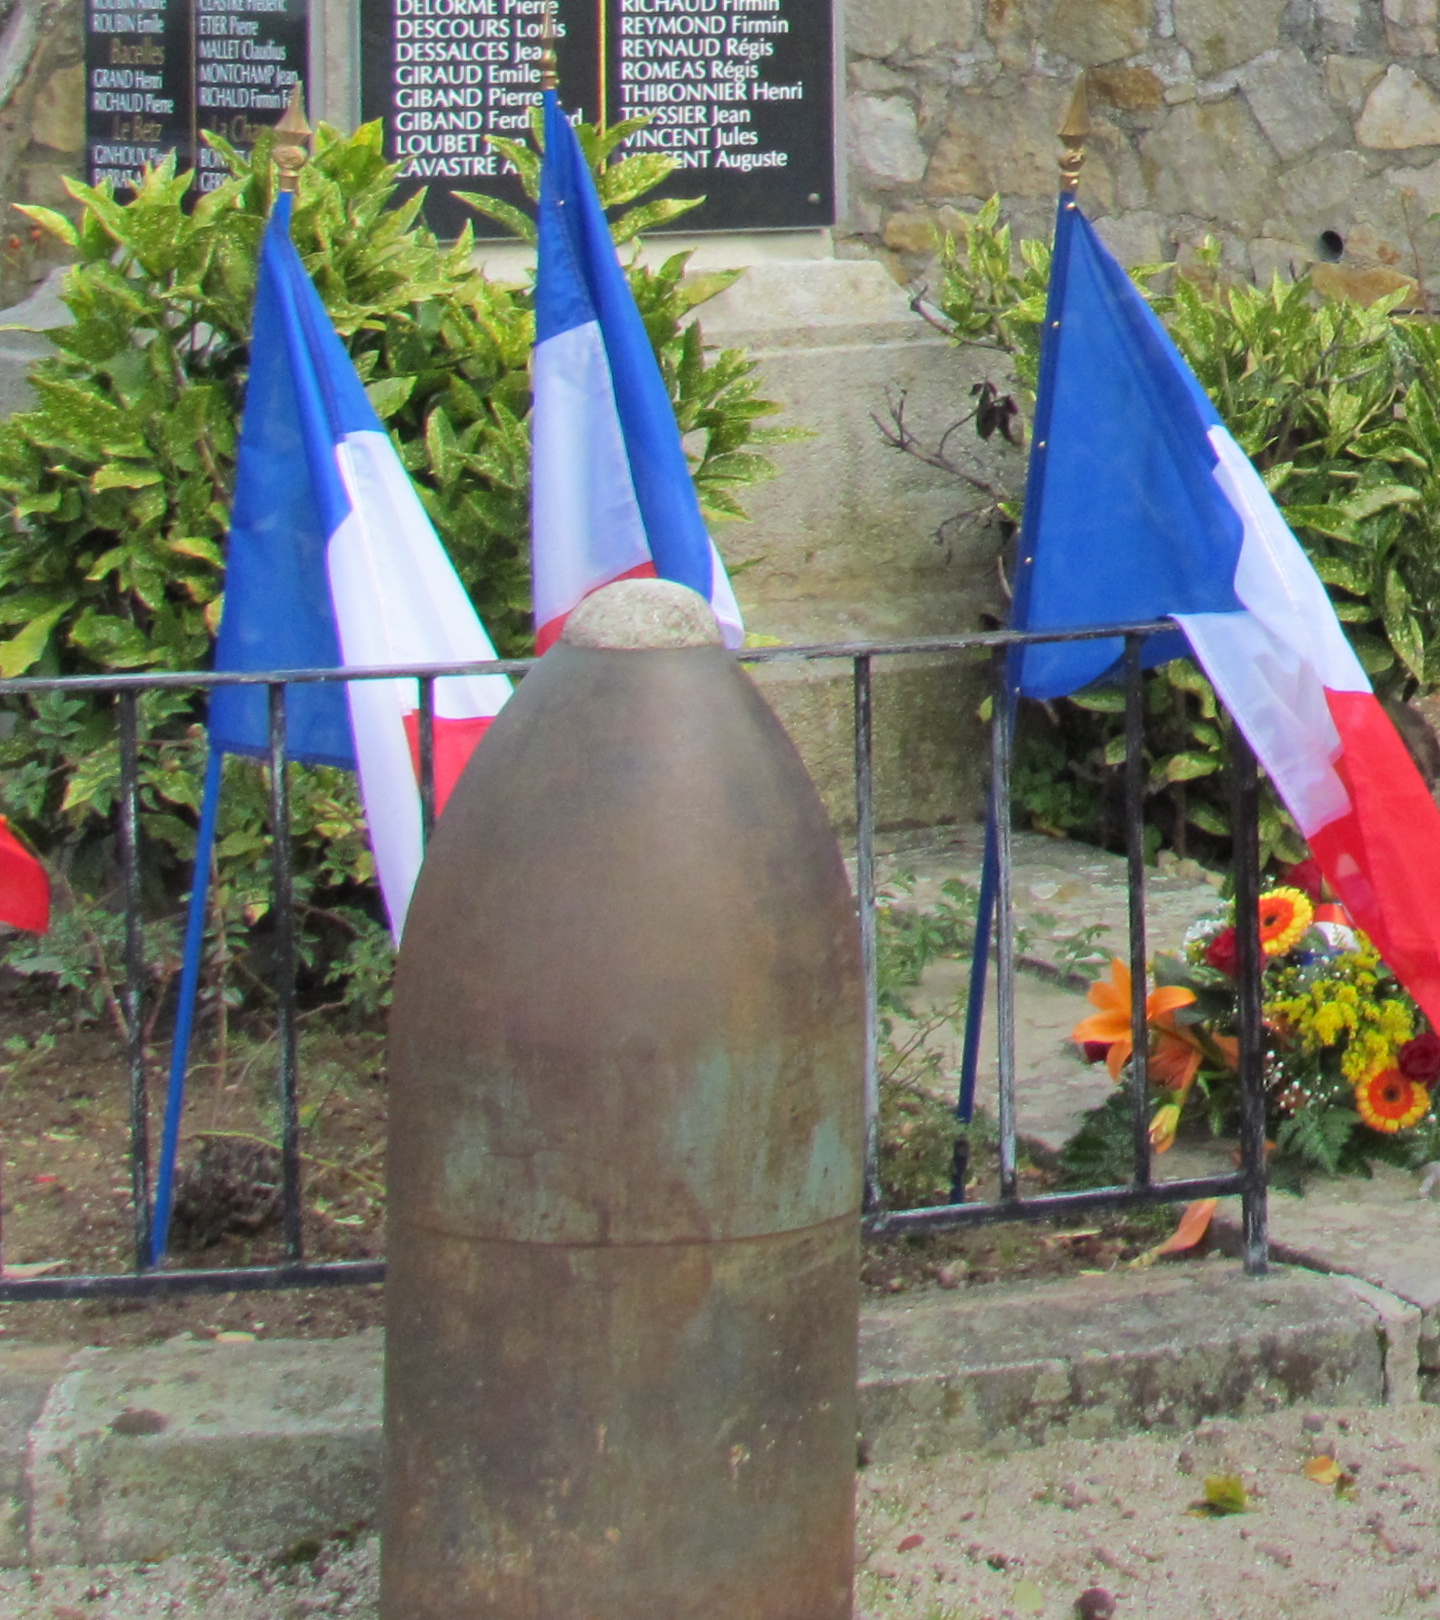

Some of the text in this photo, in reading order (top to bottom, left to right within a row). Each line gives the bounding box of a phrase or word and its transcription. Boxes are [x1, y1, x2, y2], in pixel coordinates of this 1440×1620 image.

[395, 19, 510, 39] DESCOURS
[621, 15, 789, 35] REYMOND Firmin
[395, 43, 509, 62] DESSALCES
[621, 38, 773, 60] REYNAUD Régis
[396, 64, 542, 85] GIRAUD Emile
[621, 60, 759, 82] ROMEAS Régis
[93, 92, 143, 112] RICHAUD
[396, 89, 482, 108] GIBAND
[488, 87, 544, 106] Pierre
[621, 81, 803, 103] THIBONNIER Henri
[396, 112, 482, 131] GIBAND
[712, 105, 751, 126] Jean
[396, 134, 480, 155] LOUBET
[715, 127, 758, 148] Jules
[715, 150, 788, 172] Auguste
